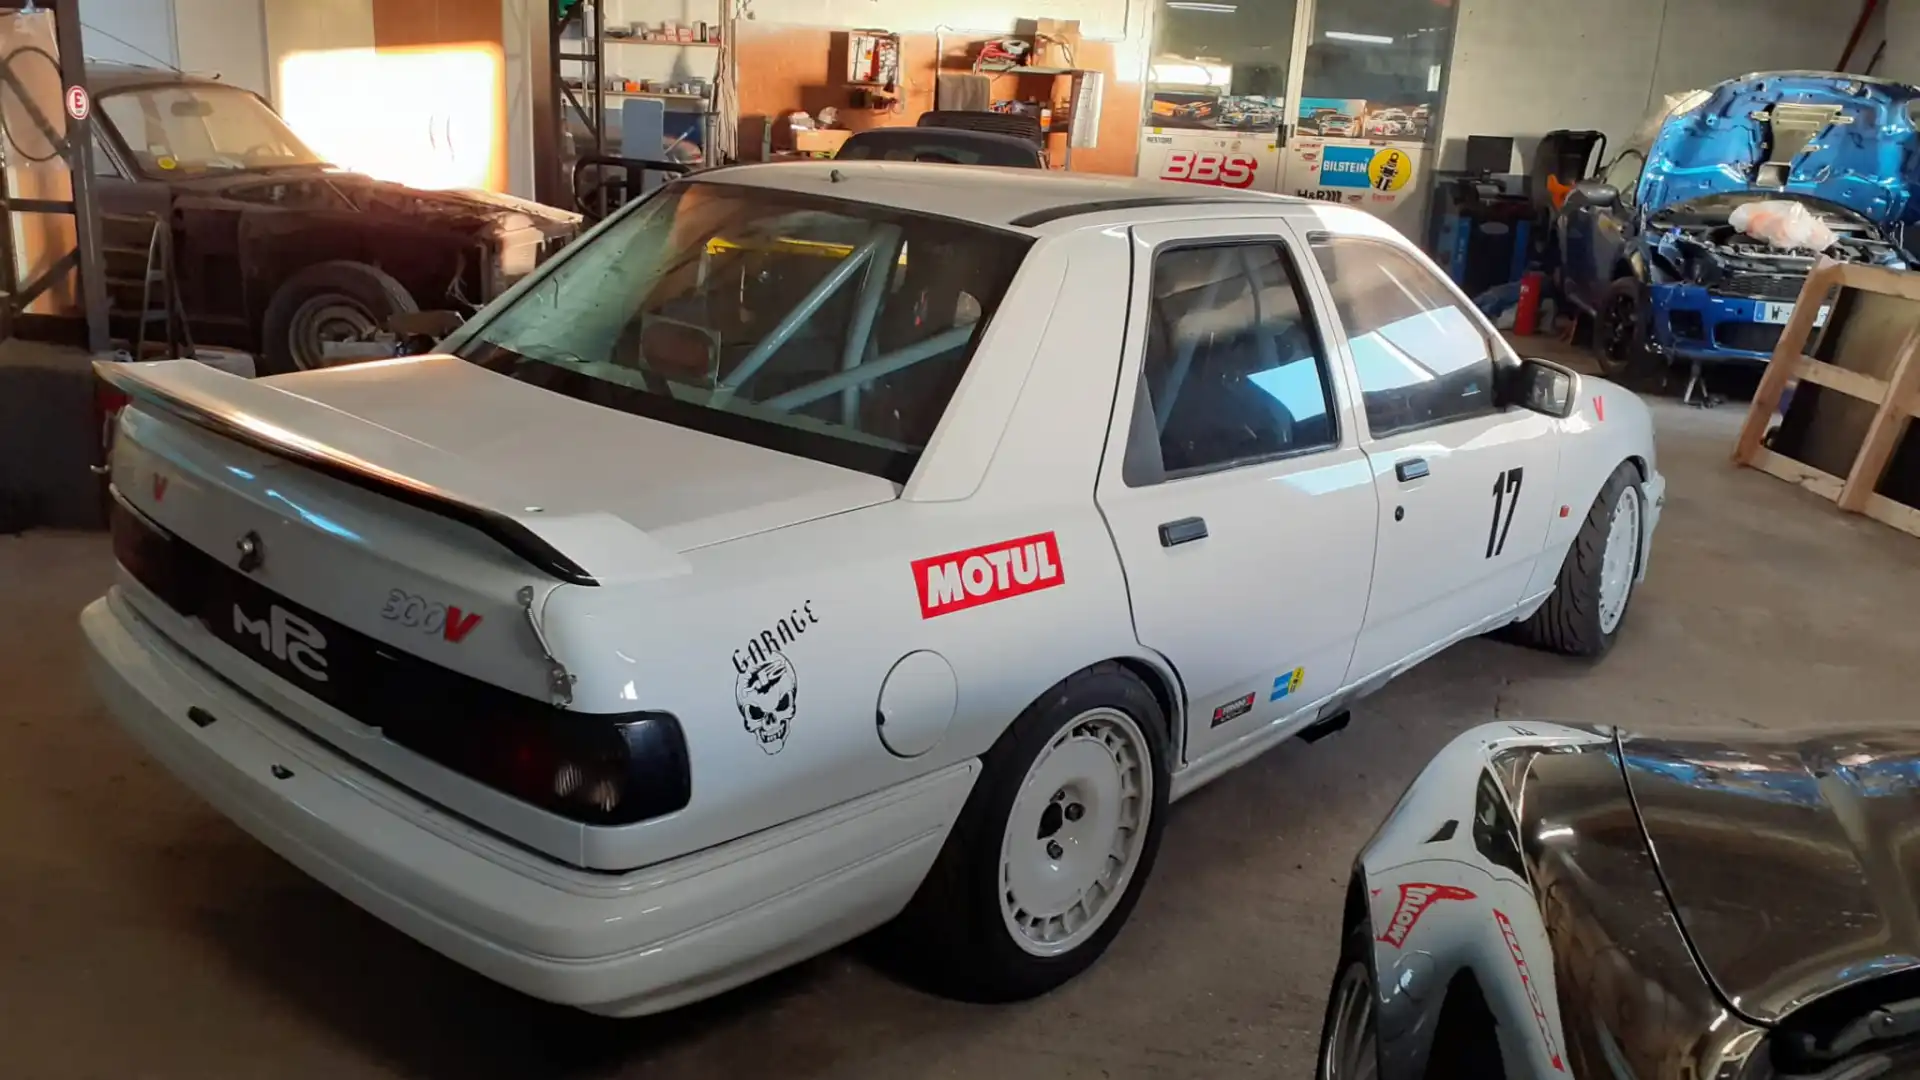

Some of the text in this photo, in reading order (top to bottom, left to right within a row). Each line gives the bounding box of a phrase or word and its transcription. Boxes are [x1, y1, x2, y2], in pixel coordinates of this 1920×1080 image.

[1160, 149, 1257, 188] BBS
[1323, 160, 1368, 174] BILSTEIN
[1593, 396, 1604, 421] V
[1485, 467, 1523, 559] 17
[926, 541, 1057, 608] MOTUL
[381, 588, 483, 643] 300V
[732, 600, 819, 674] GARAGE
